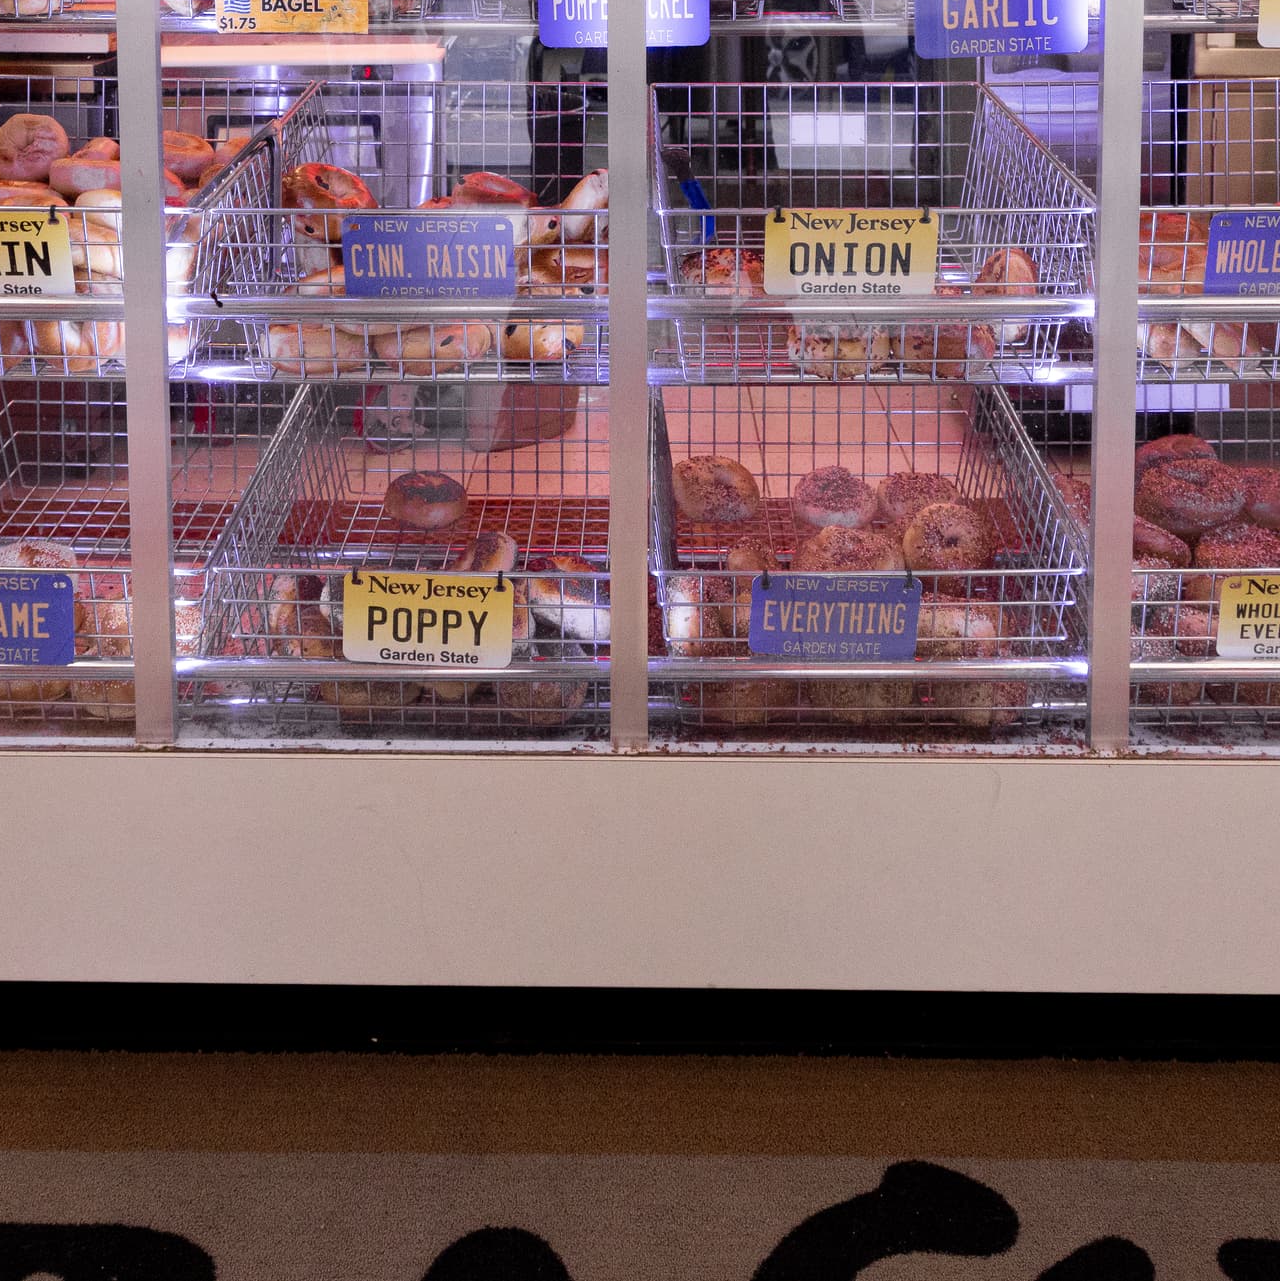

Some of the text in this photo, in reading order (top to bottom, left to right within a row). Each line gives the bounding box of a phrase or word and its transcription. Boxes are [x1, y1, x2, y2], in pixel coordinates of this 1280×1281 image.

[219, 15, 257, 33] $1.75
[350, 244, 509, 280] CINN. RAISIN
[789, 241, 914, 278] ONION
[368, 575, 492, 601] New Jersey
[366, 606, 490, 647] POPPY
[761, 601, 908, 636] EVERYTHING
